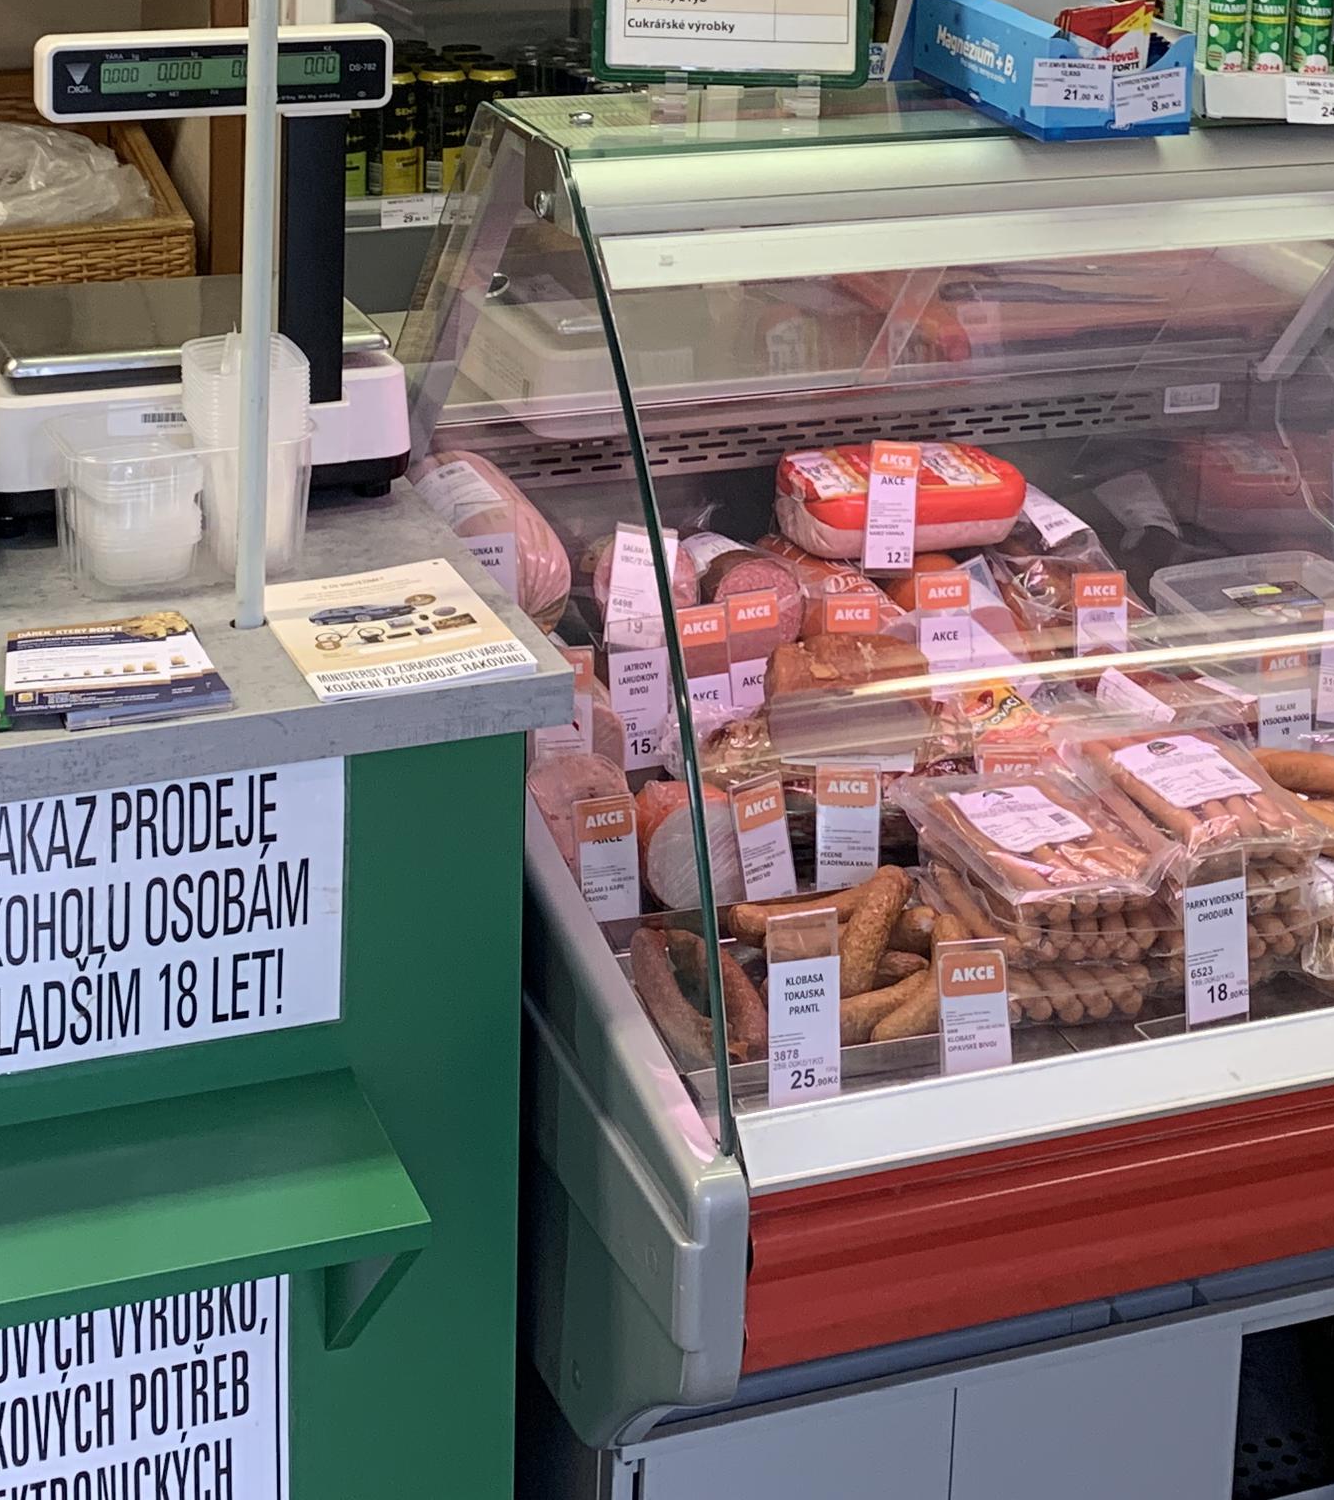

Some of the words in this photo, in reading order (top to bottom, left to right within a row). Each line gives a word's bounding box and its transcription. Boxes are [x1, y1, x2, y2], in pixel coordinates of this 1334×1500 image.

[628, 18, 685, 31] Cukrářské
[688, 20, 735, 33] výrobky
[936, 23, 995, 66] Magnézium
[1113, 60, 1140, 72] FORTE
[879, 452, 913, 468] AKCE
[886, 551, 902, 564] 12
[927, 584, 963, 601] AKCE
[1082, 583, 1117, 599] AKCE
[737, 605, 772, 621] AKCE
[834, 607, 871, 622] AKCE
[682, 619, 719, 635] AKCE
[317, 666, 395, 684] MINISTERSTVO
[398, 648, 477, 673] ZDRAVOTNICTVÍ
[325, 680, 382, 693] KOUŘENÍ
[386, 666, 459, 687] ZPŮSOBUJE
[826, 779, 869, 795] AKCE
[110, 772, 278, 863] PRODEJE
[585, 810, 625, 828] AKCE
[145, 842, 311, 949] OSOBÁM
[1186, 899, 1208, 909] PARKY
[1209, 891, 1244, 906] VIDENSKE
[1198, 908, 1233, 922] CHODURA
[785, 973, 824, 987] KLOBASA
[950, 965, 996, 984] AKCE
[1191, 966, 1213, 979] 6523
[158, 960, 197, 1032] 18
[211, 948, 286, 1025] LET!
[784, 987, 826, 1002] TOKAJSKA
[789, 1002, 820, 1015] PRANTL
[773, 1049, 800, 1062] 3878
[790, 1069, 816, 1090] 25
[129, 1343, 250, 1441] POTŘEB
